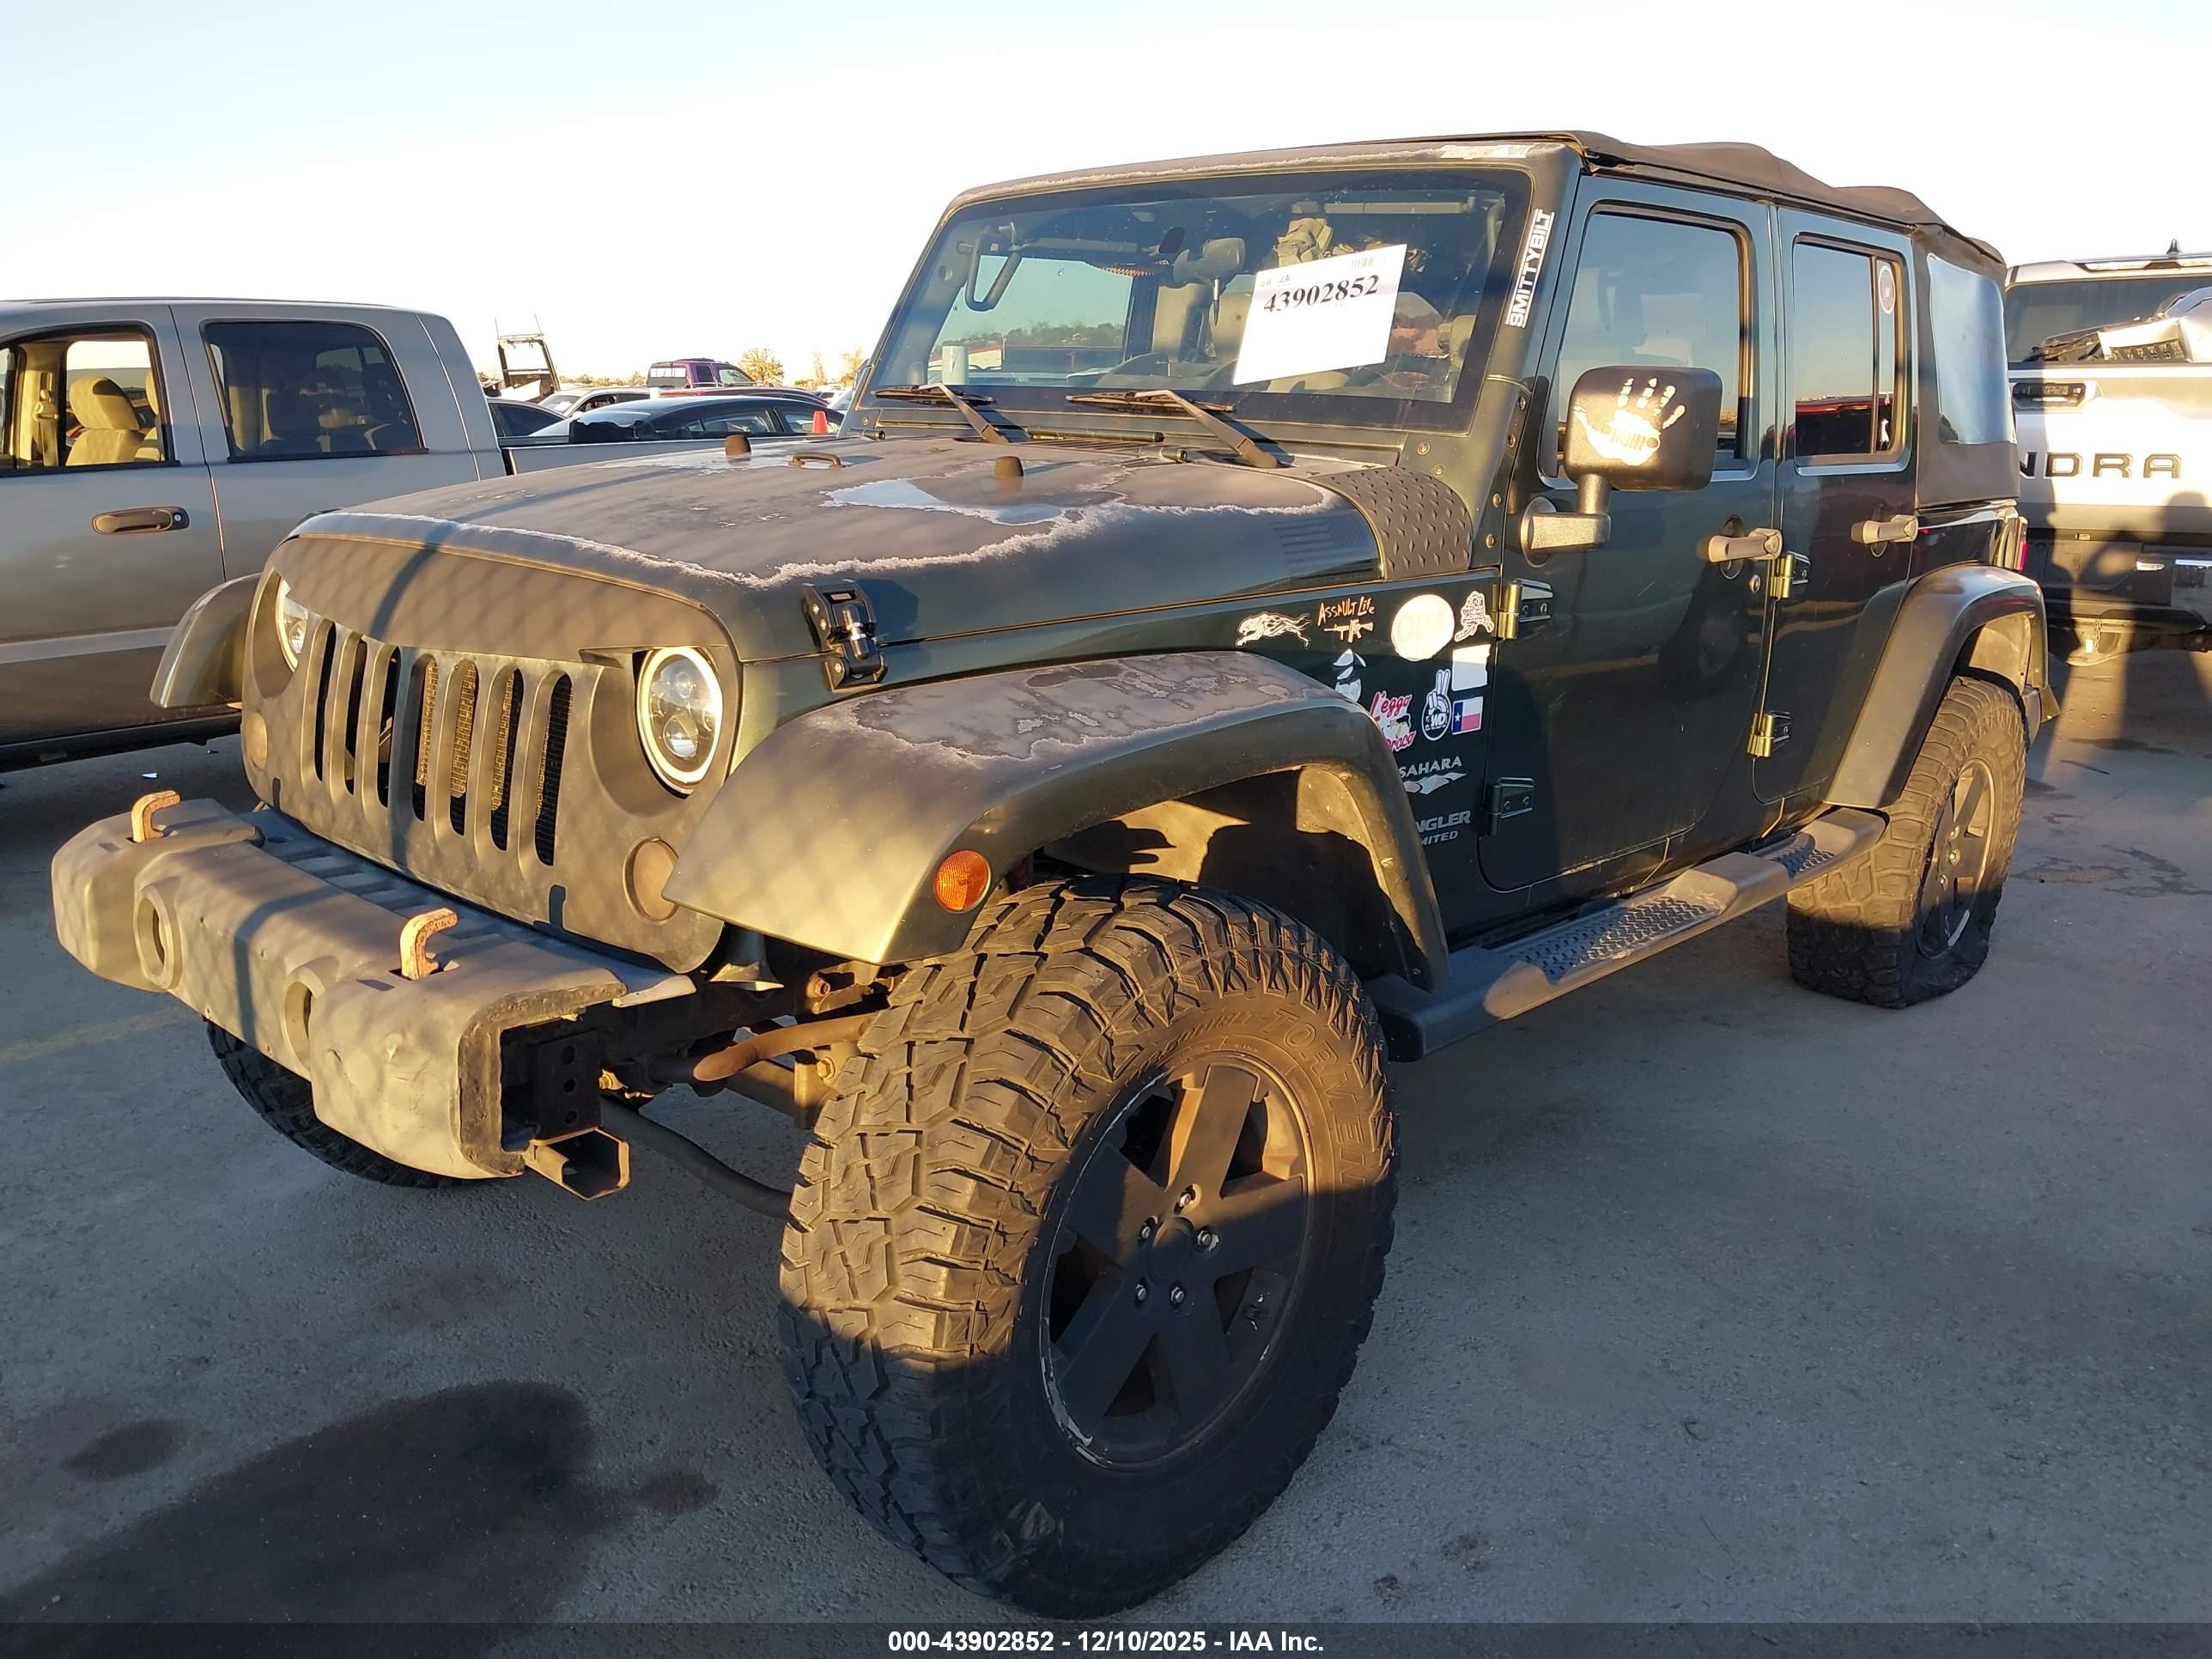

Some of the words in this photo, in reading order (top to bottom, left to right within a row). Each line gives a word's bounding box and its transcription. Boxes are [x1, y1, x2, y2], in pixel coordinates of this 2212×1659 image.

[1508, 208, 1552, 327] SMITTYBILT
[1264, 274, 1379, 312] 43902852
[1399, 756, 1462, 778] SAHARA
